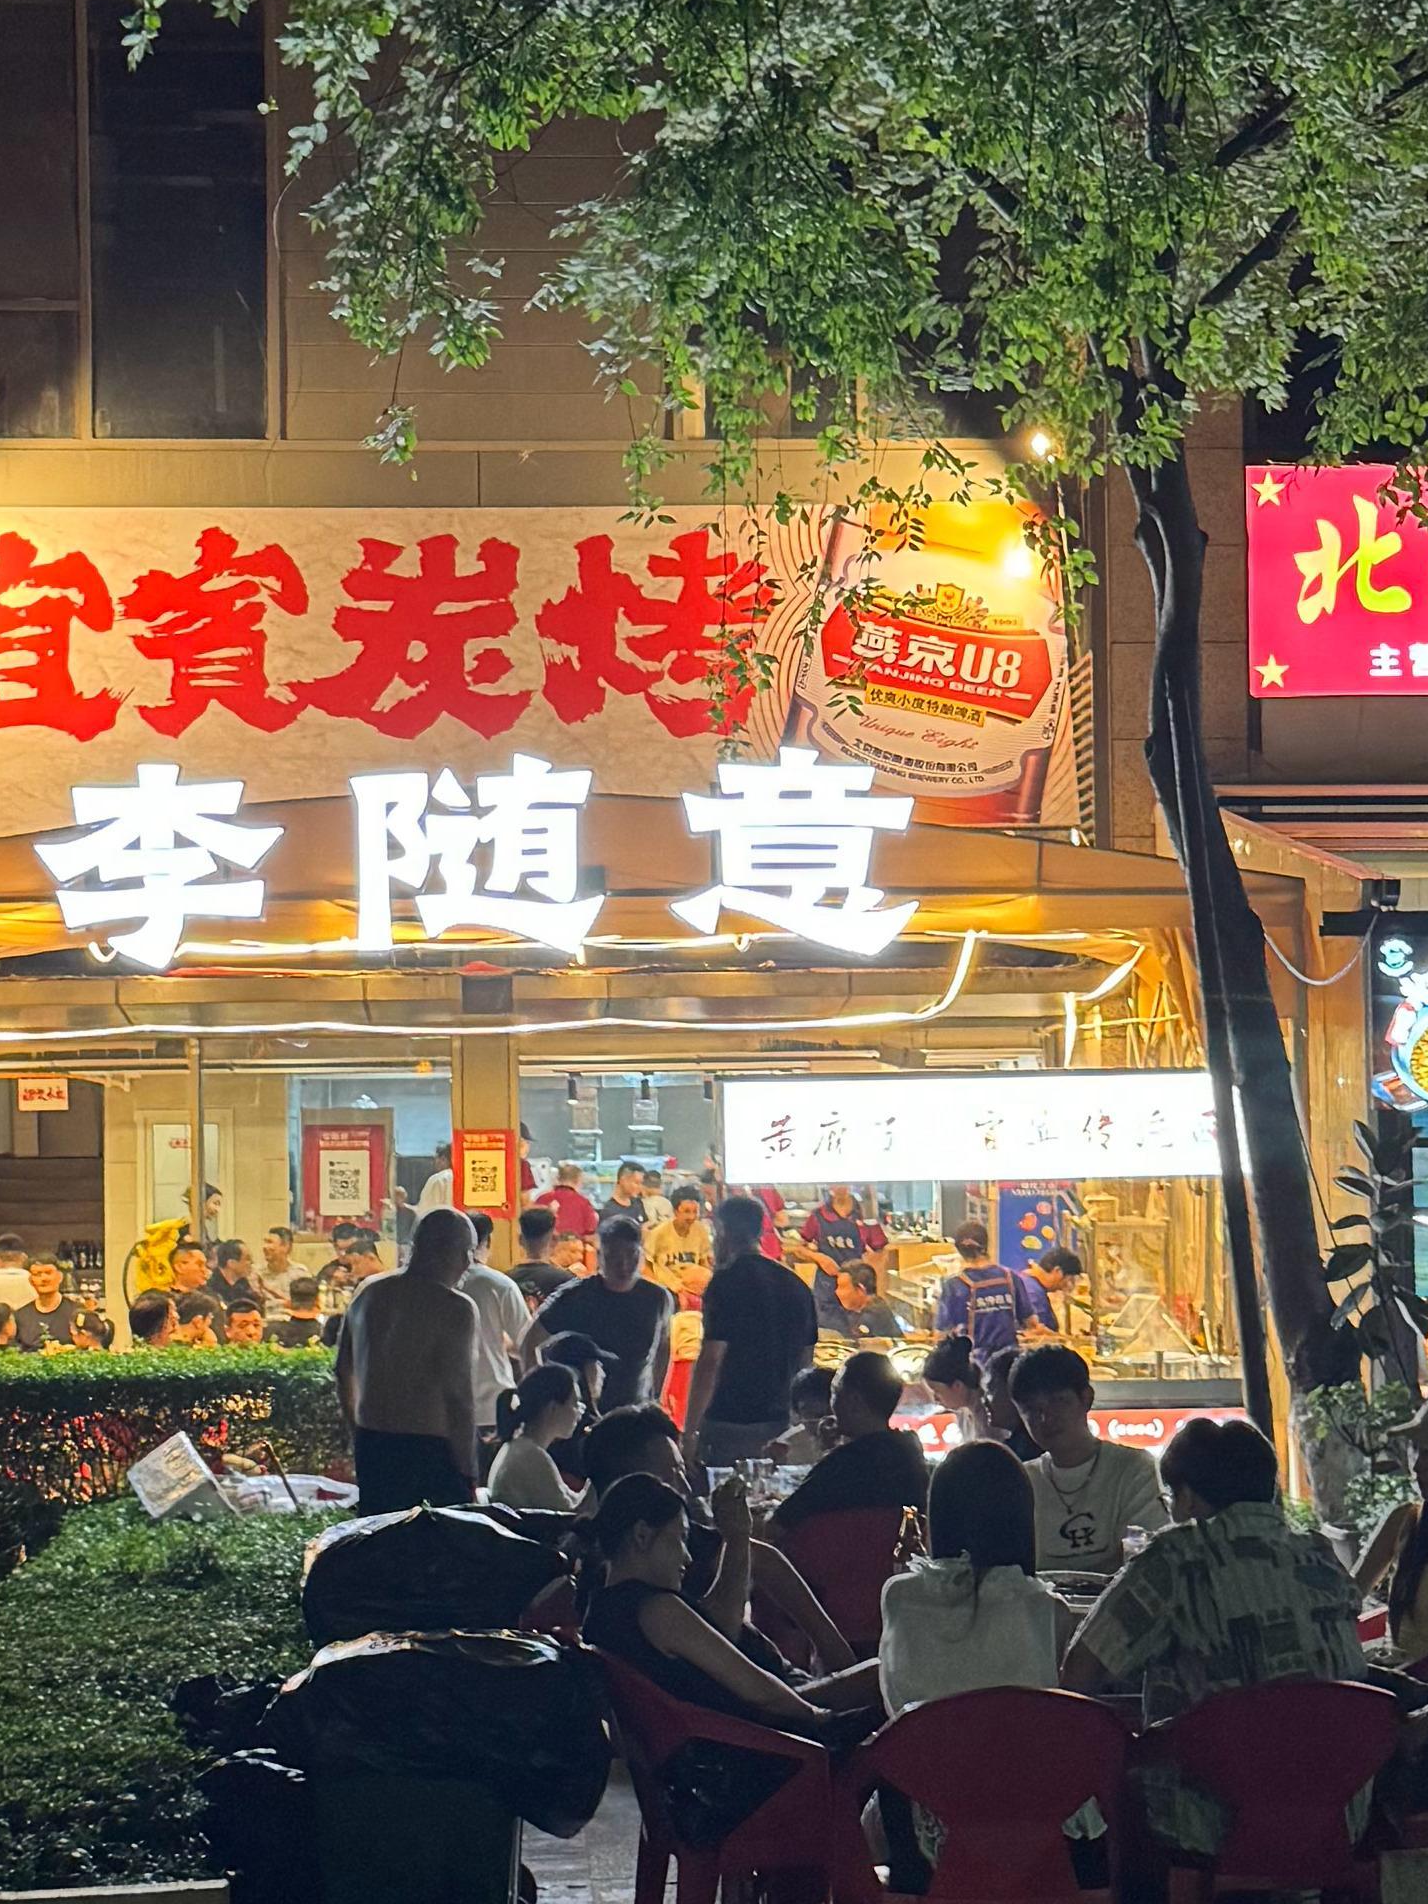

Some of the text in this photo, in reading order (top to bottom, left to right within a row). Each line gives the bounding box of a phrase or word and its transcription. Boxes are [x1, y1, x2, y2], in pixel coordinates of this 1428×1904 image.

[851, 620, 1023, 688] 燕京U8
[948, 680, 1003, 698] BEER
[33, 745, 921, 971] 李随意
